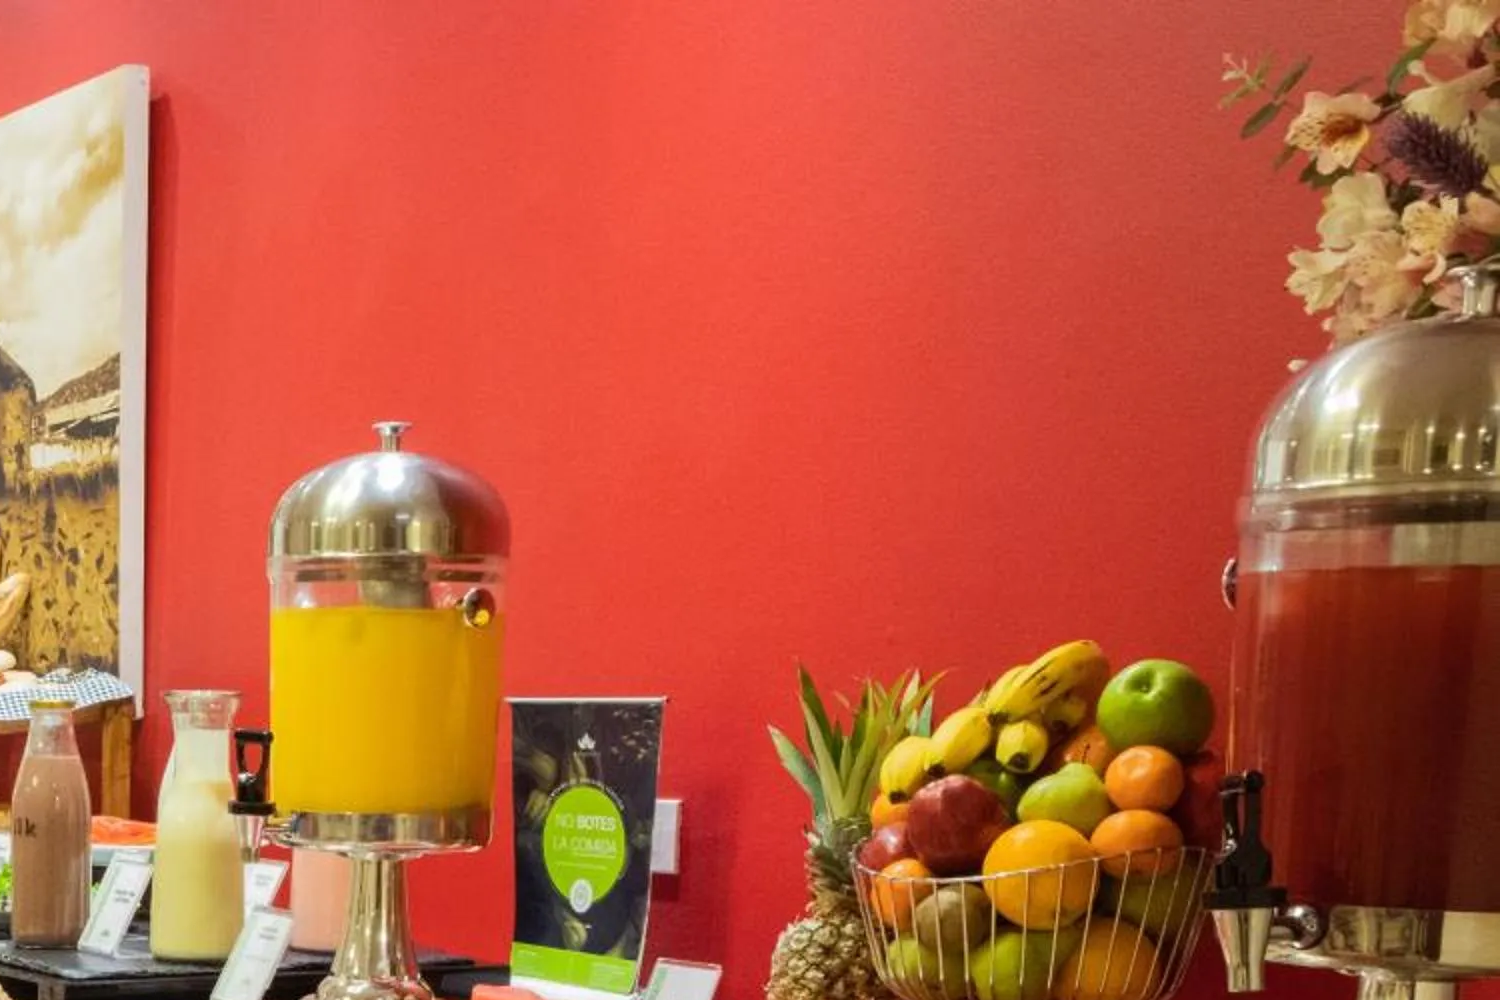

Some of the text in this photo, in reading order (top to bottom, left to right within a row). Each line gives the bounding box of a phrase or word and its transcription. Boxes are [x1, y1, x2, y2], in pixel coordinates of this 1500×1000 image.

[556, 813, 616, 832] NO BOTES
[553, 835, 568, 850] LA
